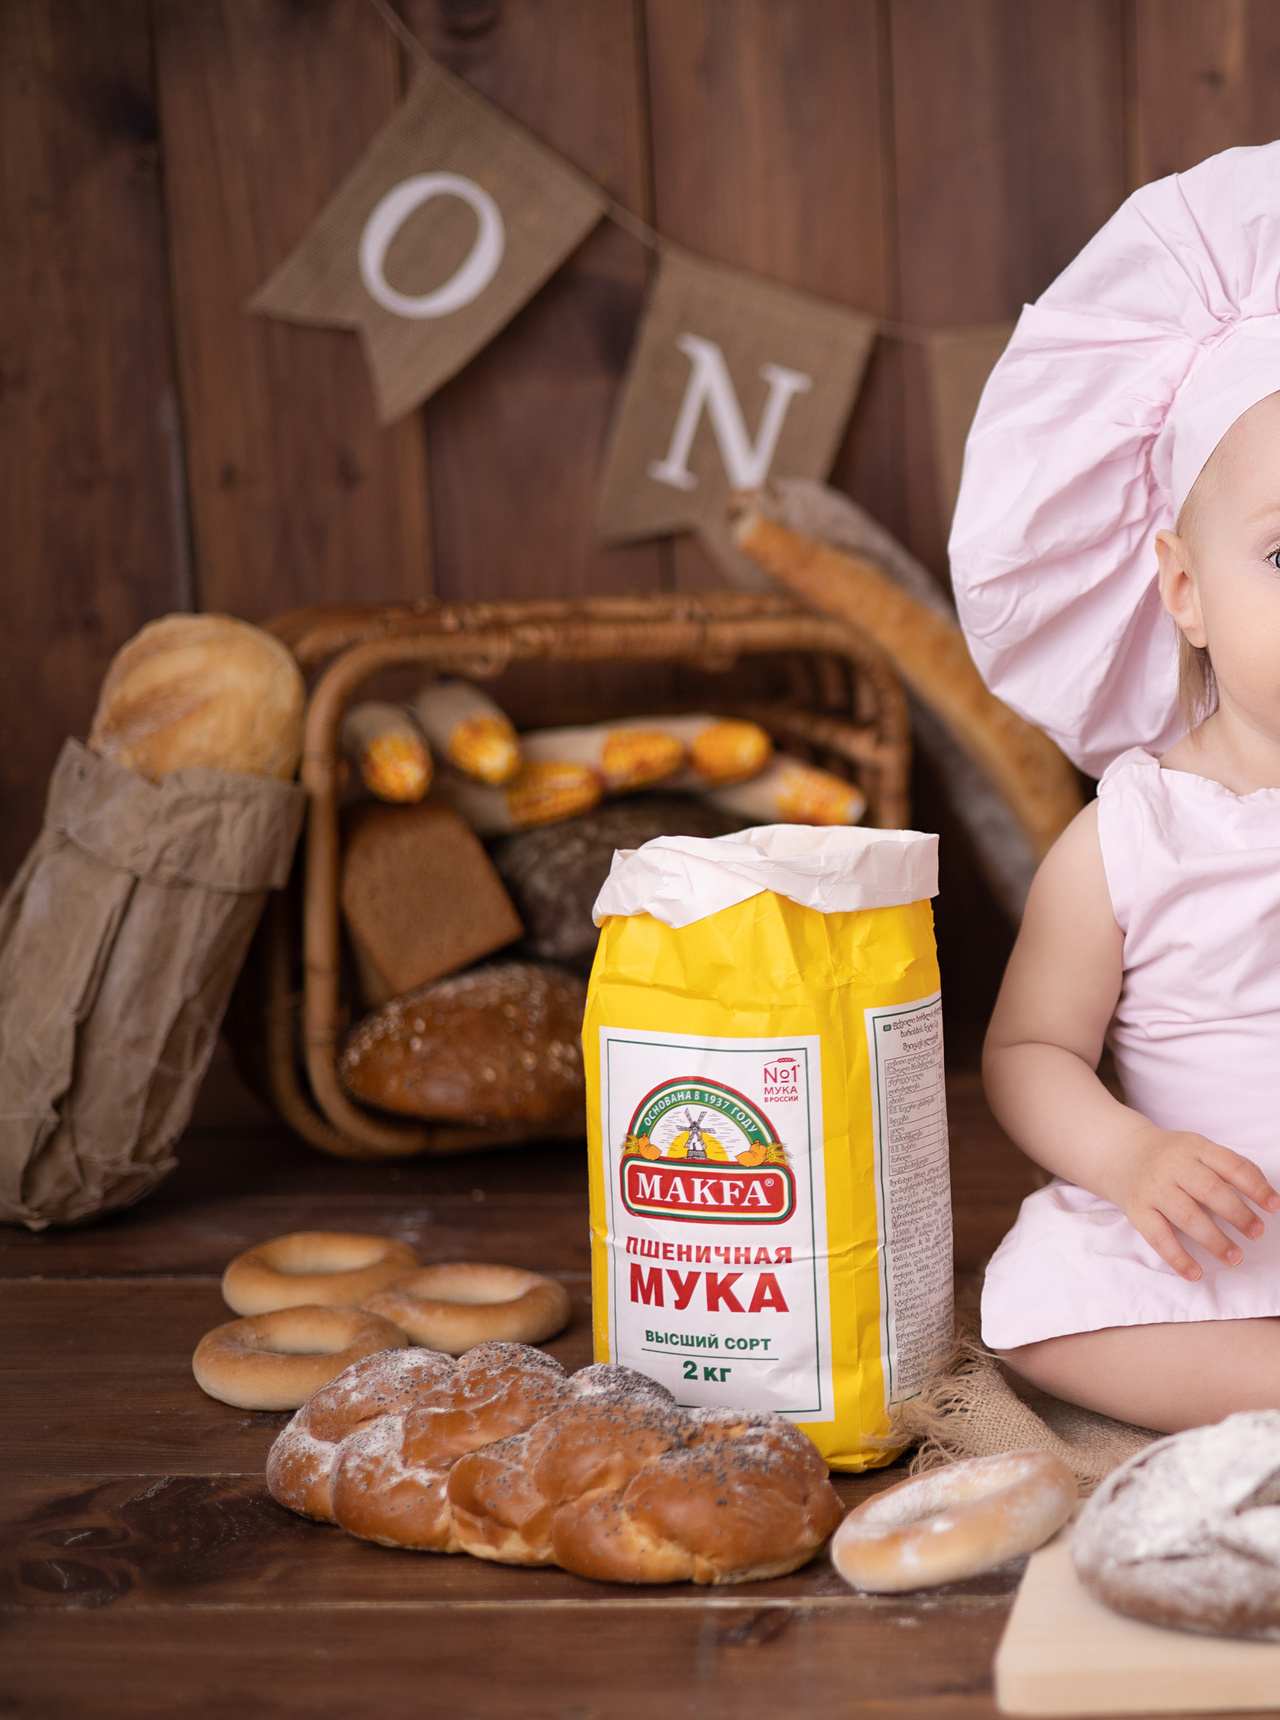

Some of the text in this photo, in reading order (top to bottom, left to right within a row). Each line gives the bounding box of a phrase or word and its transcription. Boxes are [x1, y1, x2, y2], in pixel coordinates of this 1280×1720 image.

[764, 1086, 798, 1094] МУКА
[644, 1090, 758, 1133] ОСНОВАНА В 1937 ГОДУ
[626, 1236, 792, 1264] ПШЕНИЧНАЯ
[630, 1262, 790, 1312] МУКА
[646, 1330, 772, 1350] ВЫСШИЙ СОРТ
[683, 1361, 732, 1382] 2 кг
